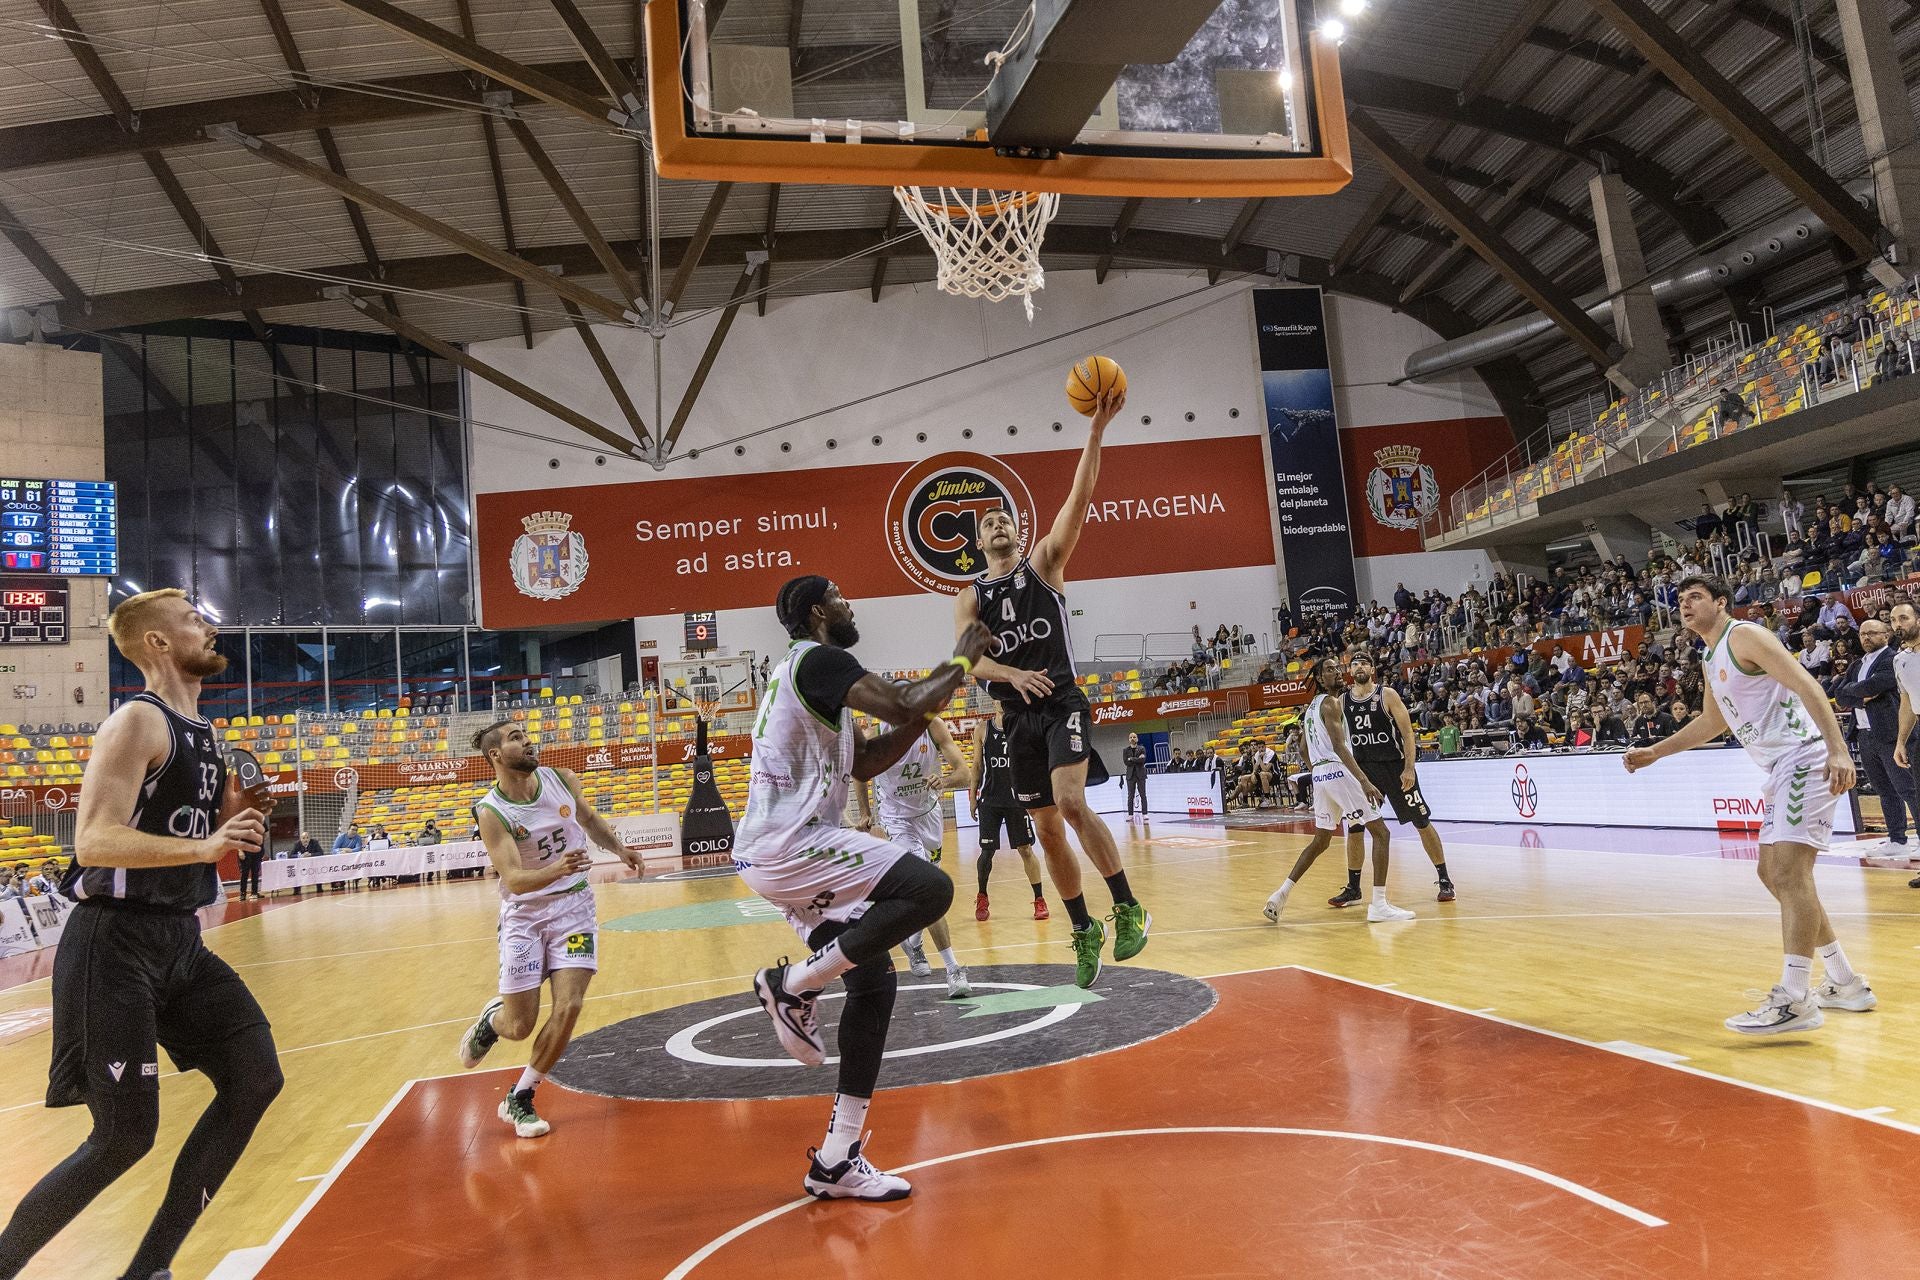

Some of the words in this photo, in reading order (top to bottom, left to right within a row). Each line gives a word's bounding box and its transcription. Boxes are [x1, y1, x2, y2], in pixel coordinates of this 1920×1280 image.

[1277, 473, 1286, 481] El
[1287, 472, 1312, 482] mejor
[2, 490, 16, 500] 61
[27, 491, 40, 501] 61
[928, 479, 985, 500] Jimbee
[1279, 485, 1319, 495] embalaje
[1085, 492, 1225, 523] ARTAGENA
[1281, 499, 1294, 508] del
[1295, 498, 1328, 509] planeta
[13, 514, 37, 526] 1:57
[636, 515, 742, 541] Semper
[757, 507, 838, 533] simul,
[1283, 523, 1346, 535] biodegradable
[676, 553, 708, 575] ad
[725, 550, 801, 571] astra.
[9, 592, 43, 605] 13:26
[1325, 602, 1348, 610] Planet
[1002, 597, 1016, 622] 4
[692, 613, 712, 622] 1:57
[696, 625, 707, 640] 9
[1093, 703, 1134, 724] Jimbee
[1066, 711, 1081, 733] 4
[1355, 714, 1371, 729] 24
[1351, 732, 1389, 746] ODILO
[1002, 741, 1008, 754] 7
[586, 753, 612, 763] CRC
[990, 757, 1010, 768] ODI
[901, 762, 922, 780] 42
[200, 762, 218, 800] 33
[1405, 790, 1422, 807] 24
[1713, 798, 1765, 815] PRIM
[168, 807, 210, 839] ODI
[625, 826, 672, 836] Ayuntamiento
[537, 827, 567, 860] 55
[625, 833, 672, 845] Cartagena
[689, 838, 729, 853] ODILO
